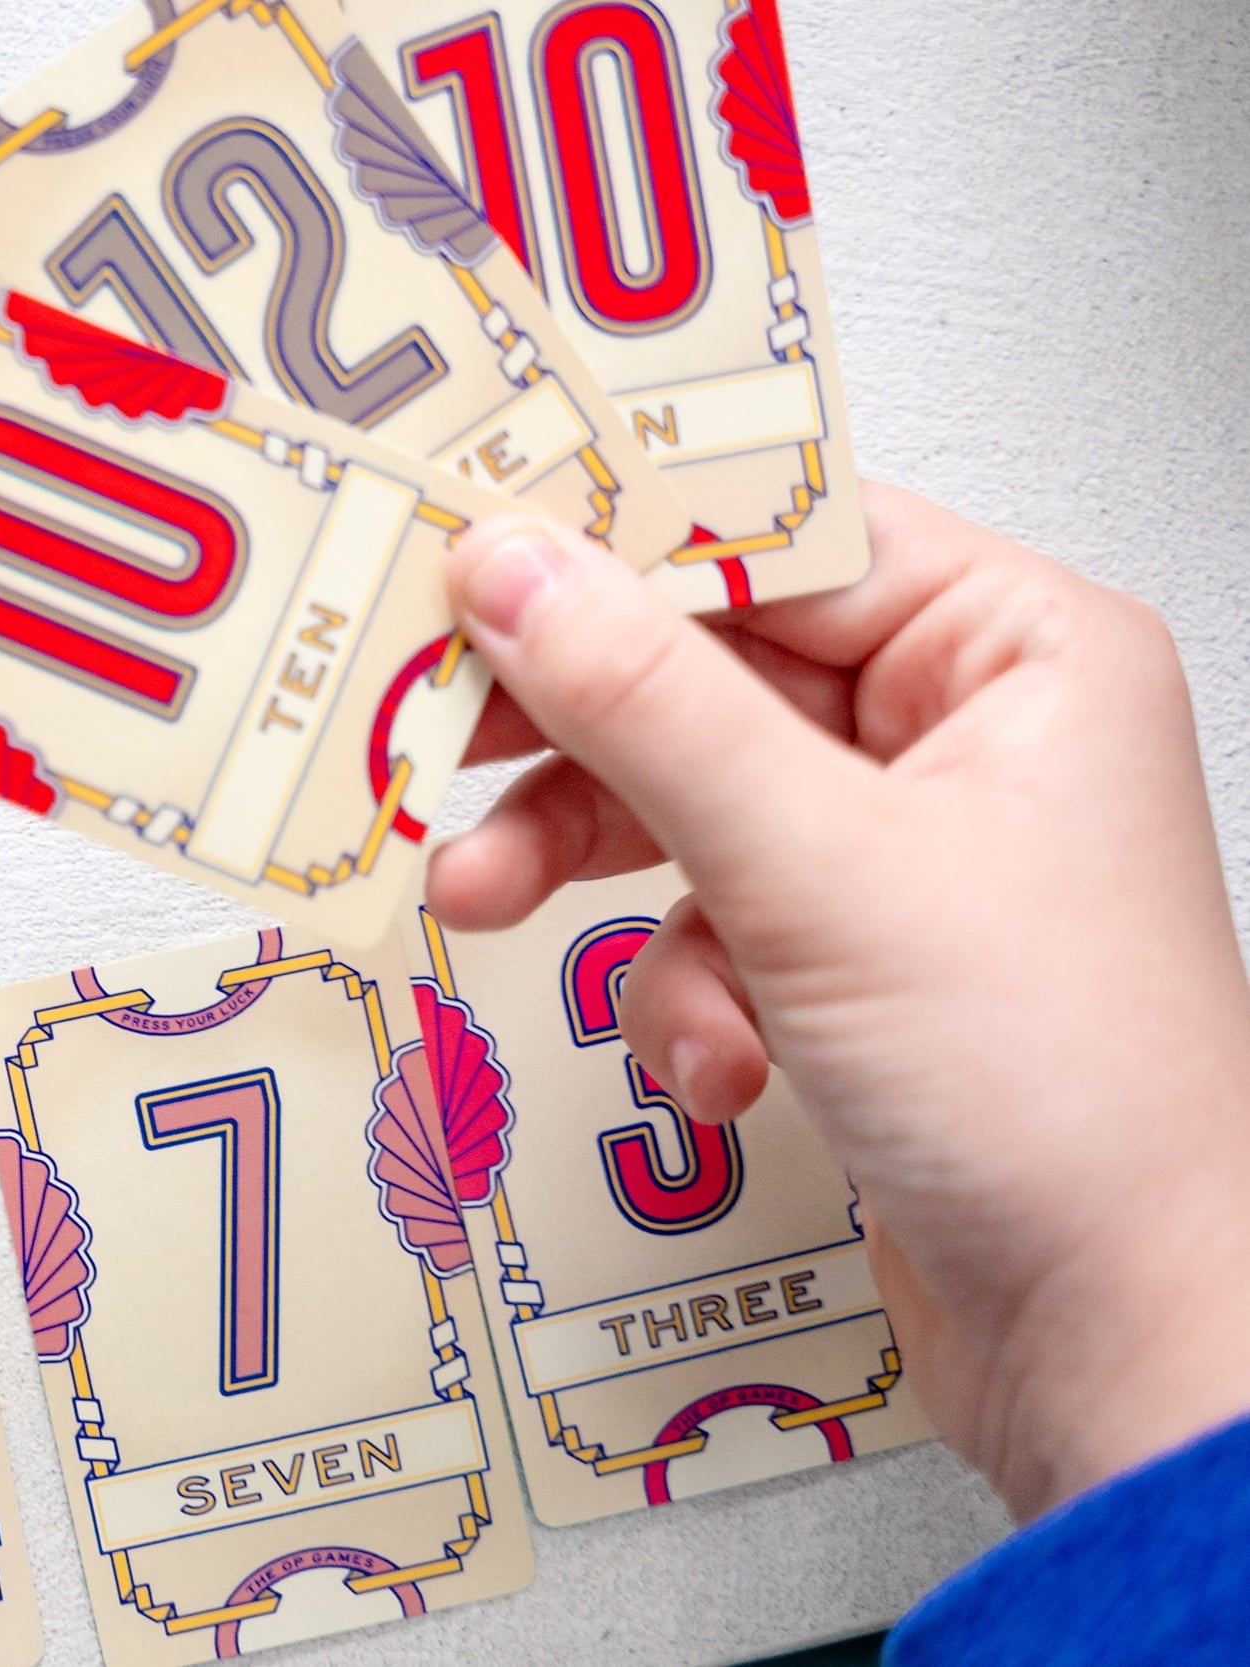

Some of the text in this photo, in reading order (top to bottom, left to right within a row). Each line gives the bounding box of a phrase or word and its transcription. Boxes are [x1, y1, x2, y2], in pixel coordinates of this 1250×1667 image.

[399, 0, 713, 337] 10
[44, 115, 450, 432] 12
[258, 602, 347, 732] TEN
[121, 987, 255, 1031] PRESS YOUR LUCK
[561, 915, 744, 1236] 3
[134, 1068, 281, 1397] 7
[599, 1270, 823, 1357] THREE
[178, 1432, 404, 1517] SEVEN
[246, 1552, 375, 1595] THE OP GAMES
